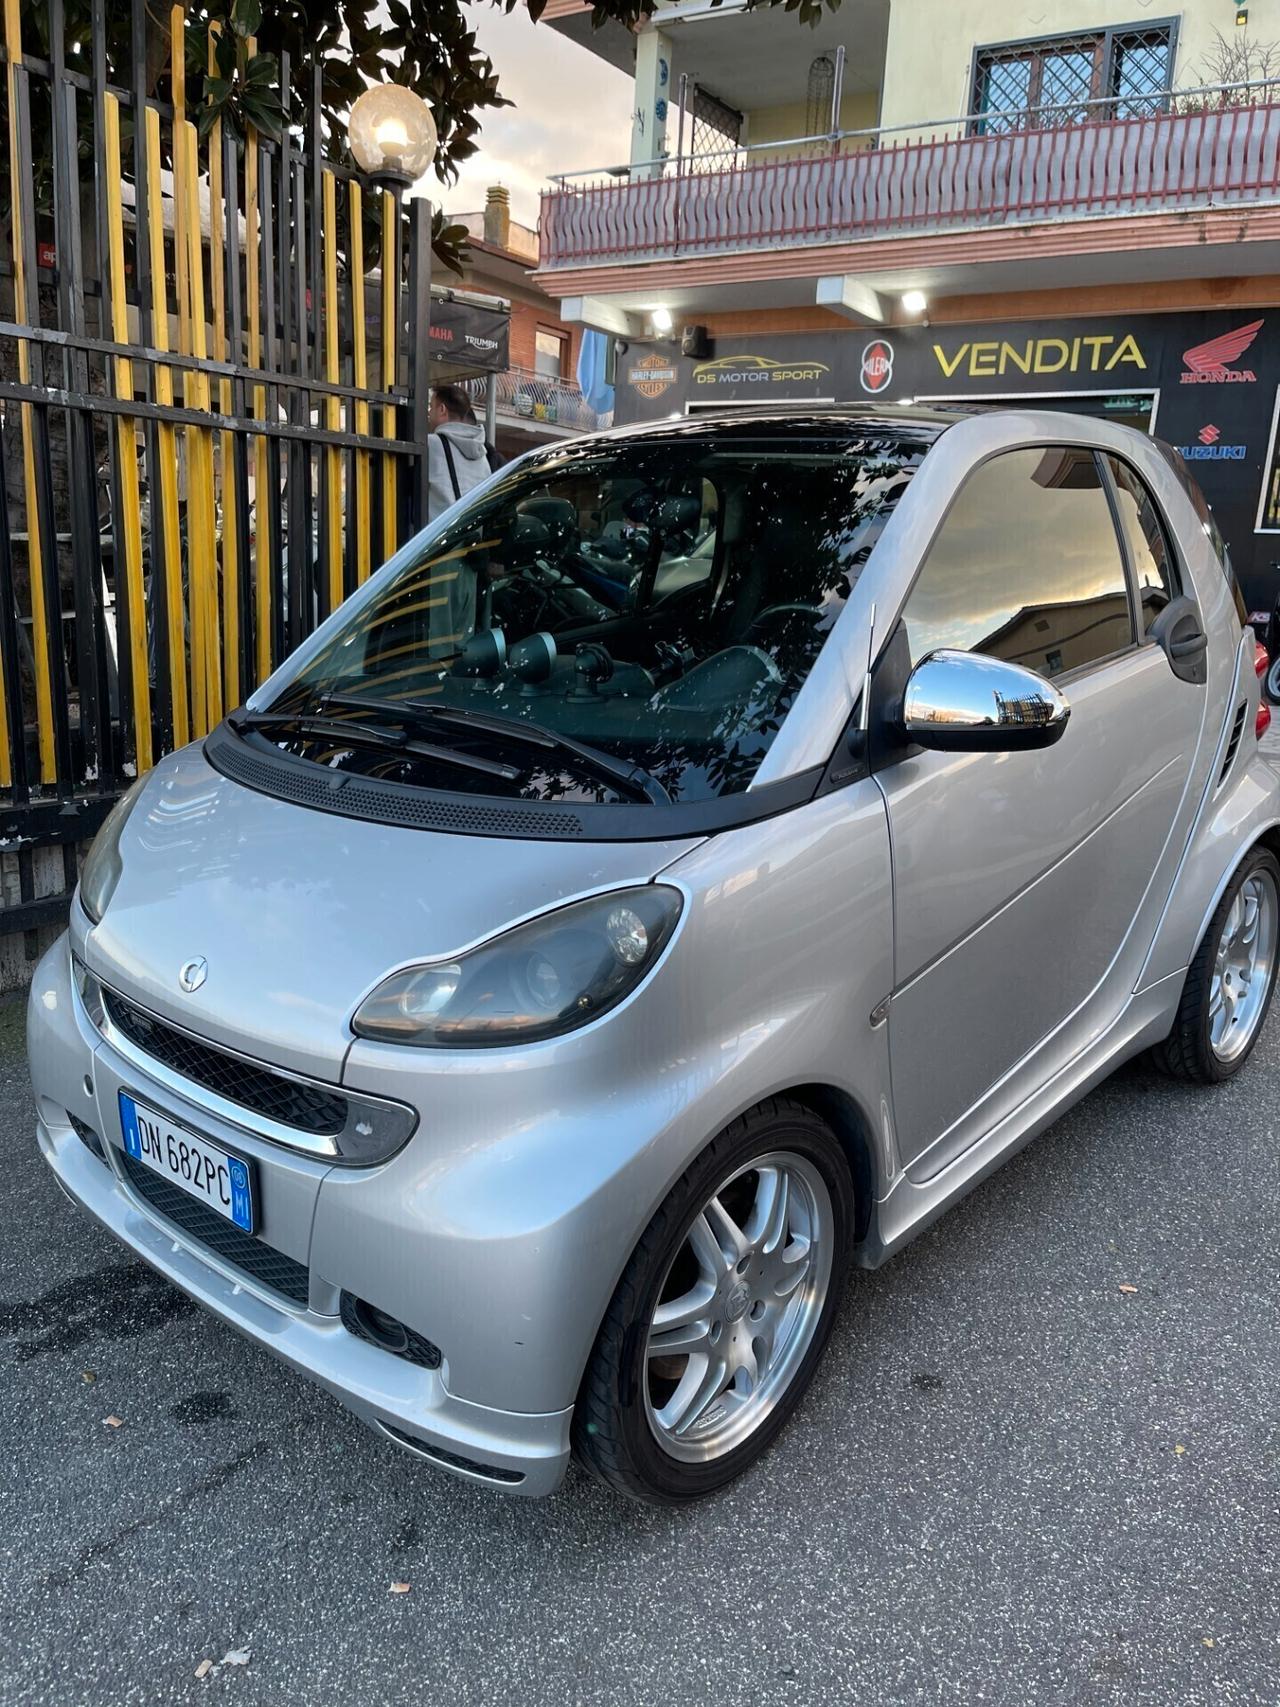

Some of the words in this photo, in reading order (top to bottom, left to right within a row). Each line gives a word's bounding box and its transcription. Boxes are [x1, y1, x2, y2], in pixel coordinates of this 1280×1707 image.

[429, 326, 453, 342] MAHA
[464, 335, 498, 349] TRIUMPH
[933, 334, 1147, 378] VENDITA
[697, 374, 716, 384] DS
[718, 371, 769, 383] MOTOR
[772, 369, 822, 381] SPORT
[1179, 370, 1257, 384] HONDA
[137, 1116, 162, 1164] DN
[167, 1135, 231, 1205] 682PC
[235, 1191, 249, 1220] MI
